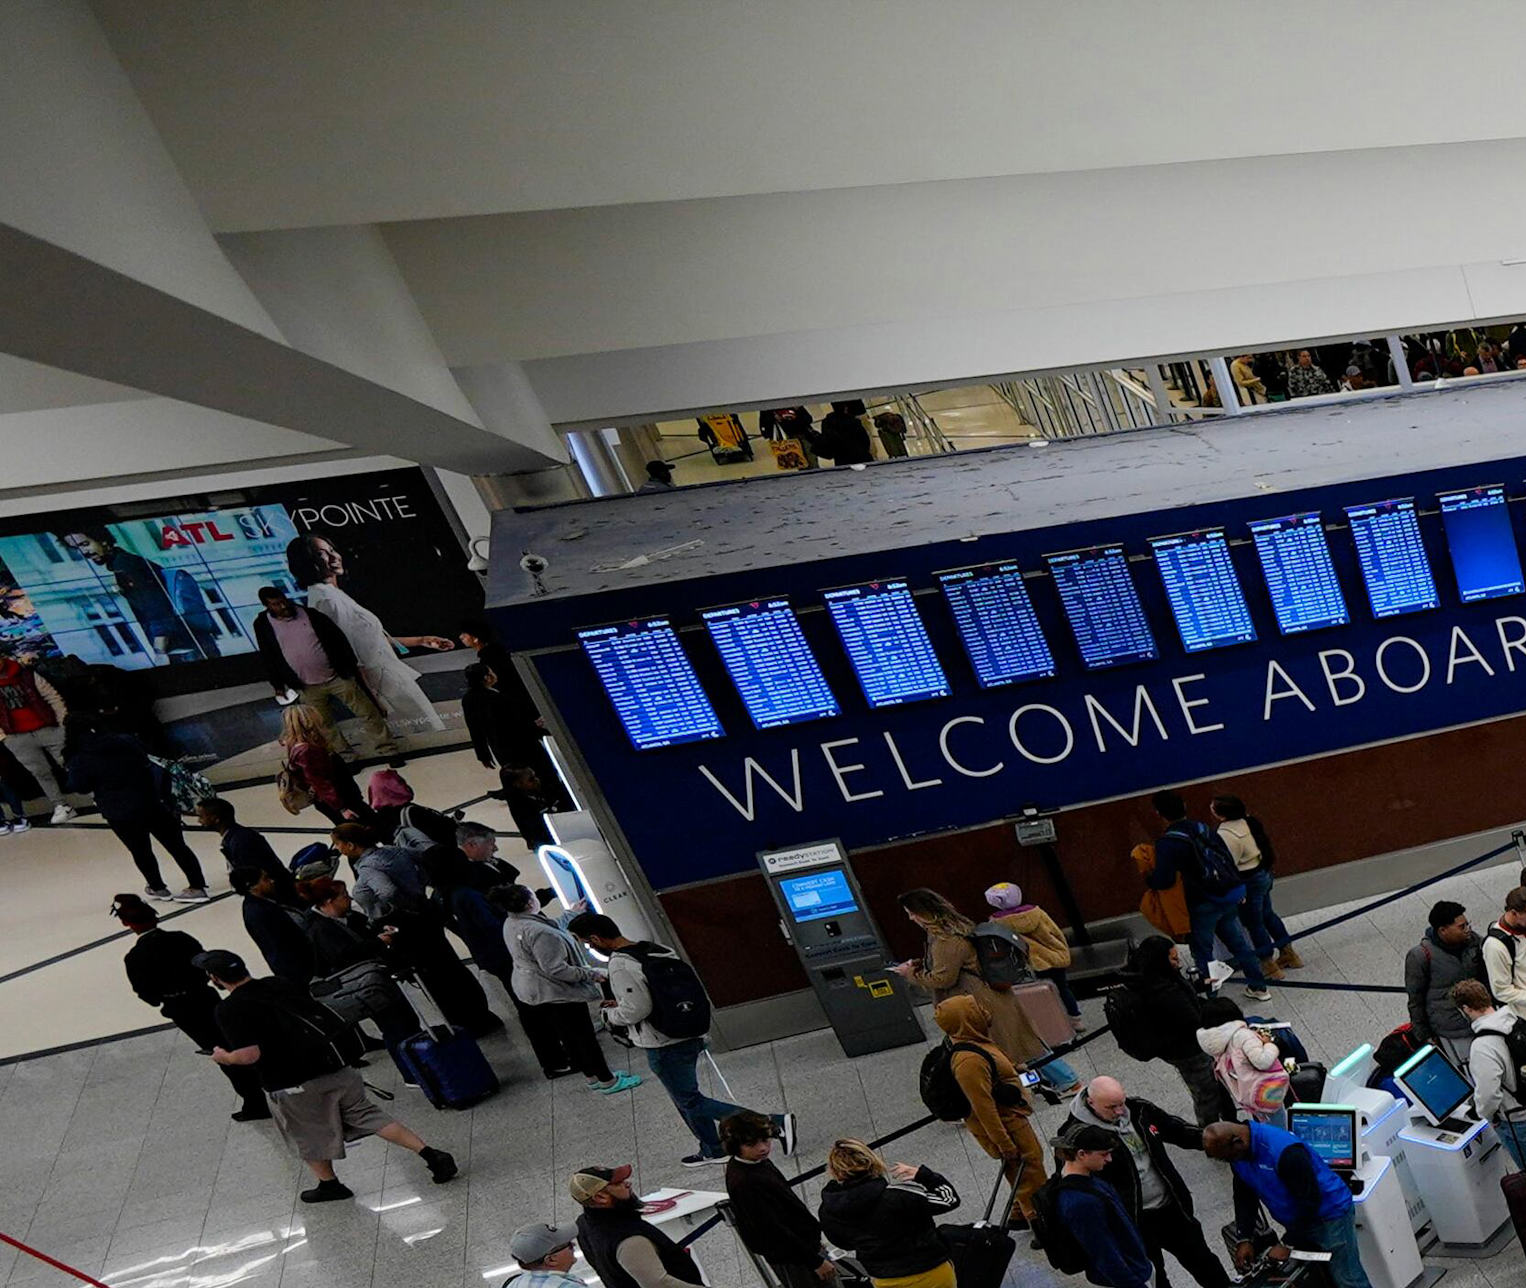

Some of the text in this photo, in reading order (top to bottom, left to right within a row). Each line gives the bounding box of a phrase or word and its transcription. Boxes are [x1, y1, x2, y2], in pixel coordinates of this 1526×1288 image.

[160, 495, 416, 550] ATL SKYPOINTE
[698, 673, 1224, 821] WELCOME
[603, 891, 627, 904] CLEAR
